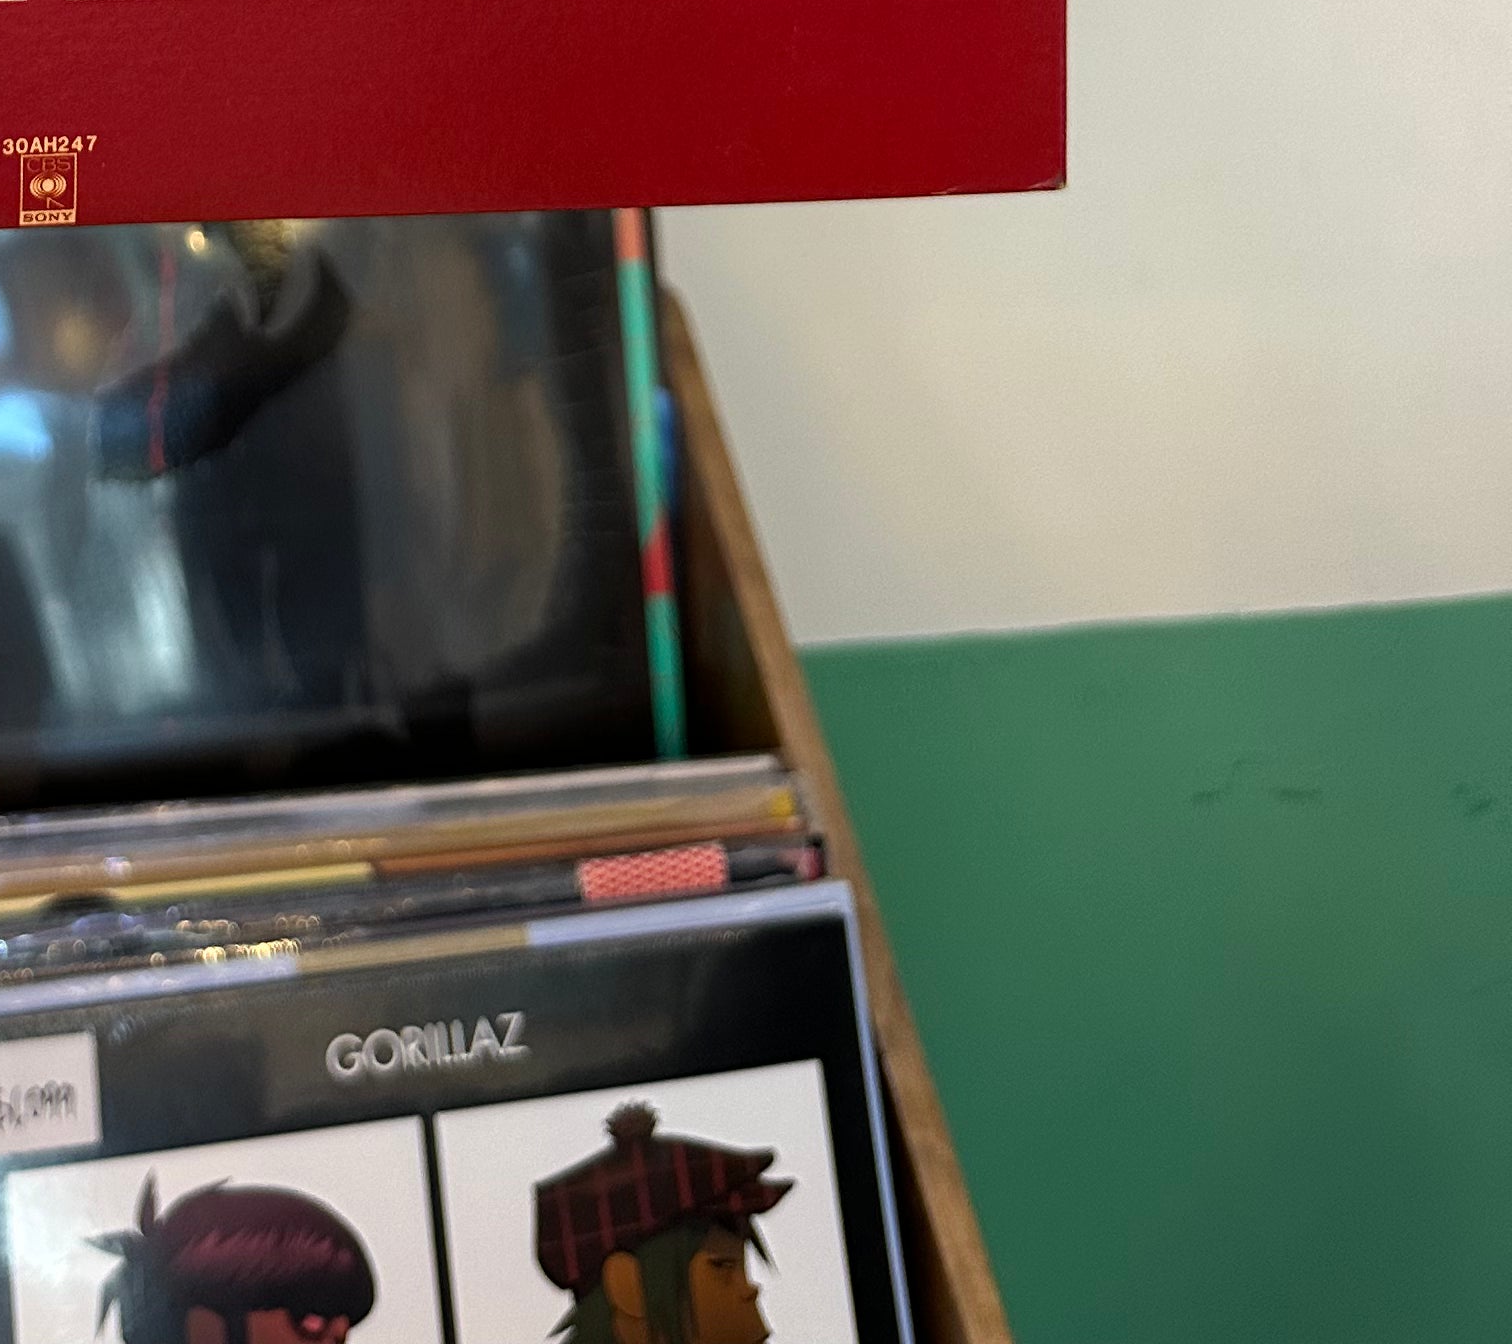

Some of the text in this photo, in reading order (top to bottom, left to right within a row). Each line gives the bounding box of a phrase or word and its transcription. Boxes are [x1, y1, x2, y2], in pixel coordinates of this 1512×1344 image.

[1, 134, 98, 155] 30AH247
[26, 157, 72, 172] CBS
[22, 211, 73, 223] SONY
[324, 1011, 528, 1081] GORILLAZ
